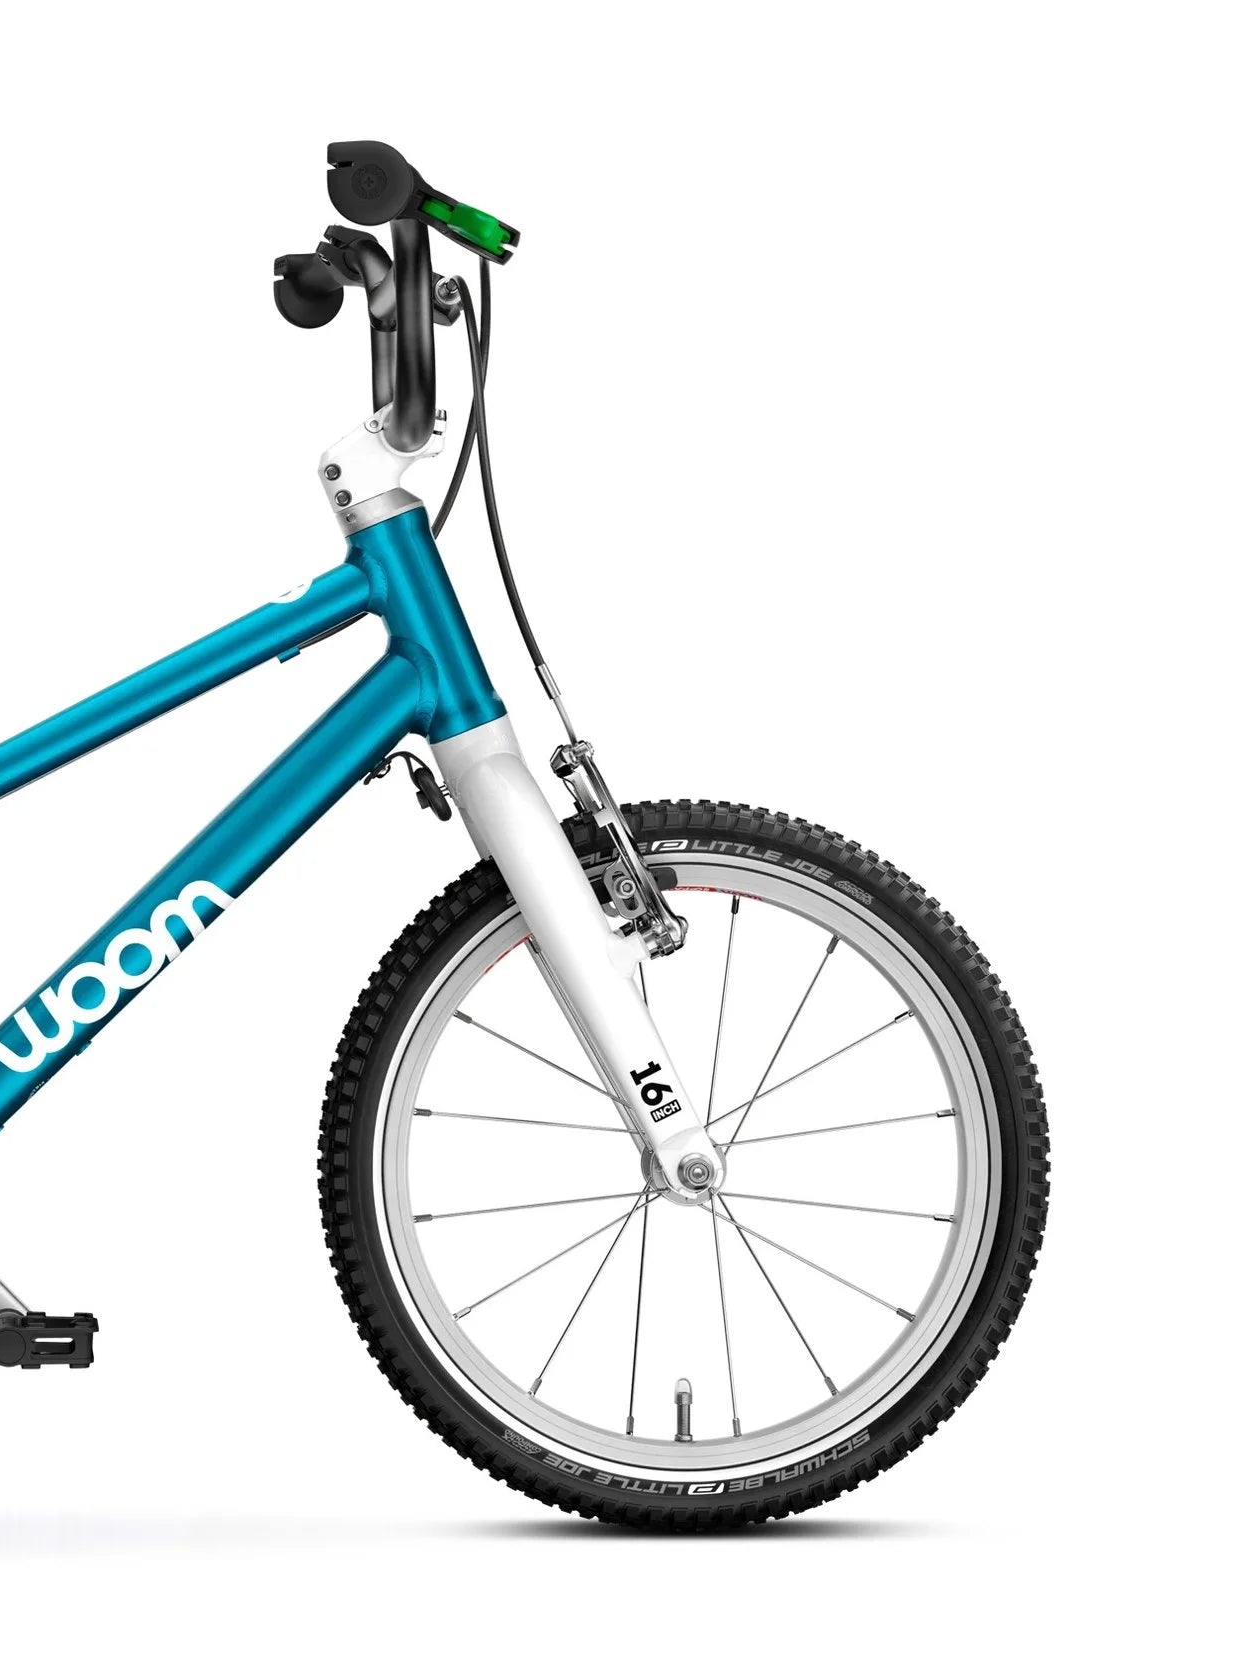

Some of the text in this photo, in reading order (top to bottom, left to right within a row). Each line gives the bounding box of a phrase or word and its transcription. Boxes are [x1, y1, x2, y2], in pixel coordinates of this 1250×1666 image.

[691, 839, 834, 882] LITTLE JOE
[629, 1060, 674, 1106] 16
[652, 1101, 680, 1121] INCH
[543, 1428, 872, 1497] SCHWALBE LITTLE JOE
